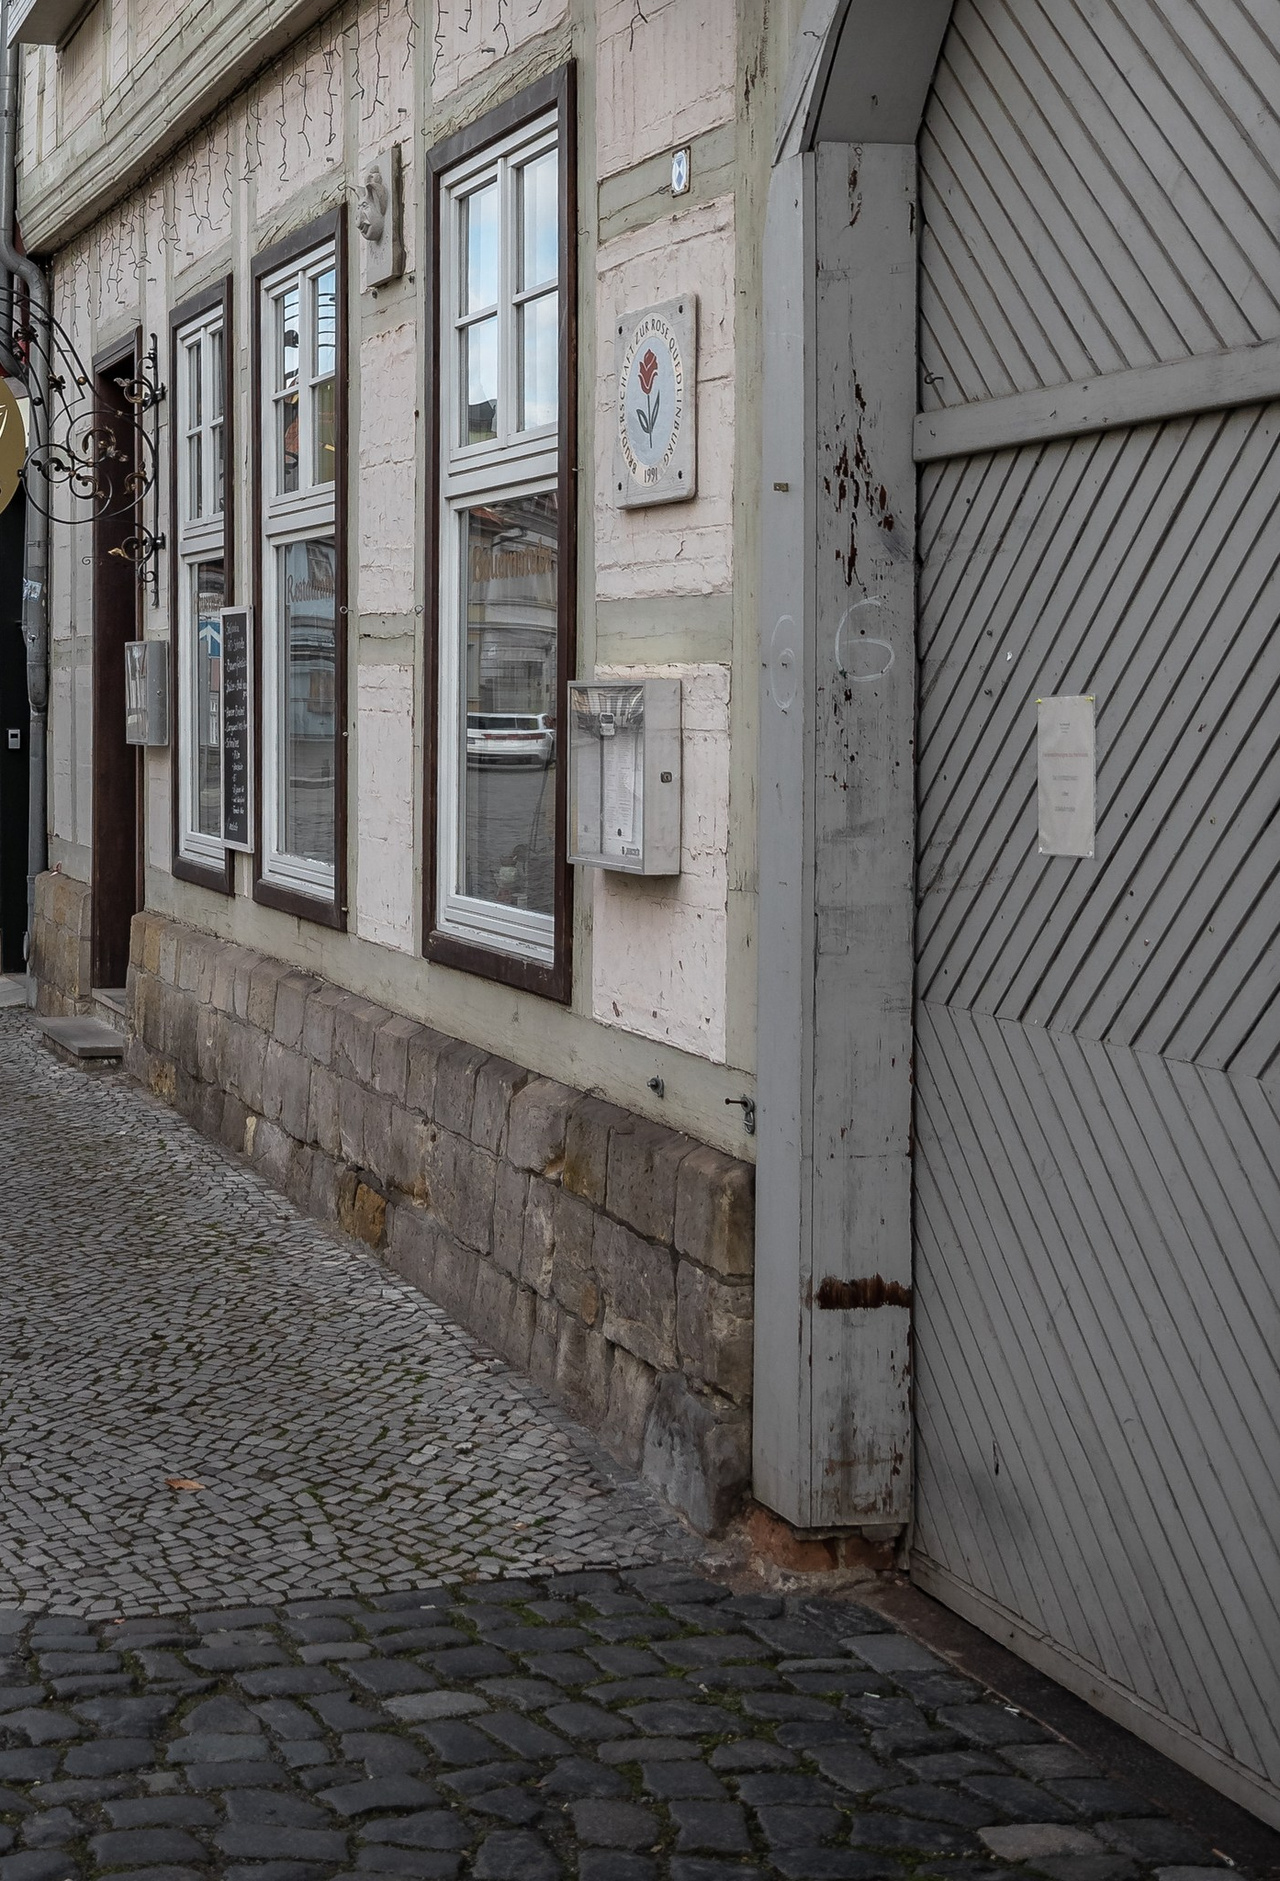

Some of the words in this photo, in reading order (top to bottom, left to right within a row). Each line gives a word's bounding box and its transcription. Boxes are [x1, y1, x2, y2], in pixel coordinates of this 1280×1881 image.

[633, 322, 651, 346] ZUR
[650, 318, 670, 341] ROSE
[663, 336, 684, 467] QUEDLINBURG
[643, 467, 659, 484] 1991
